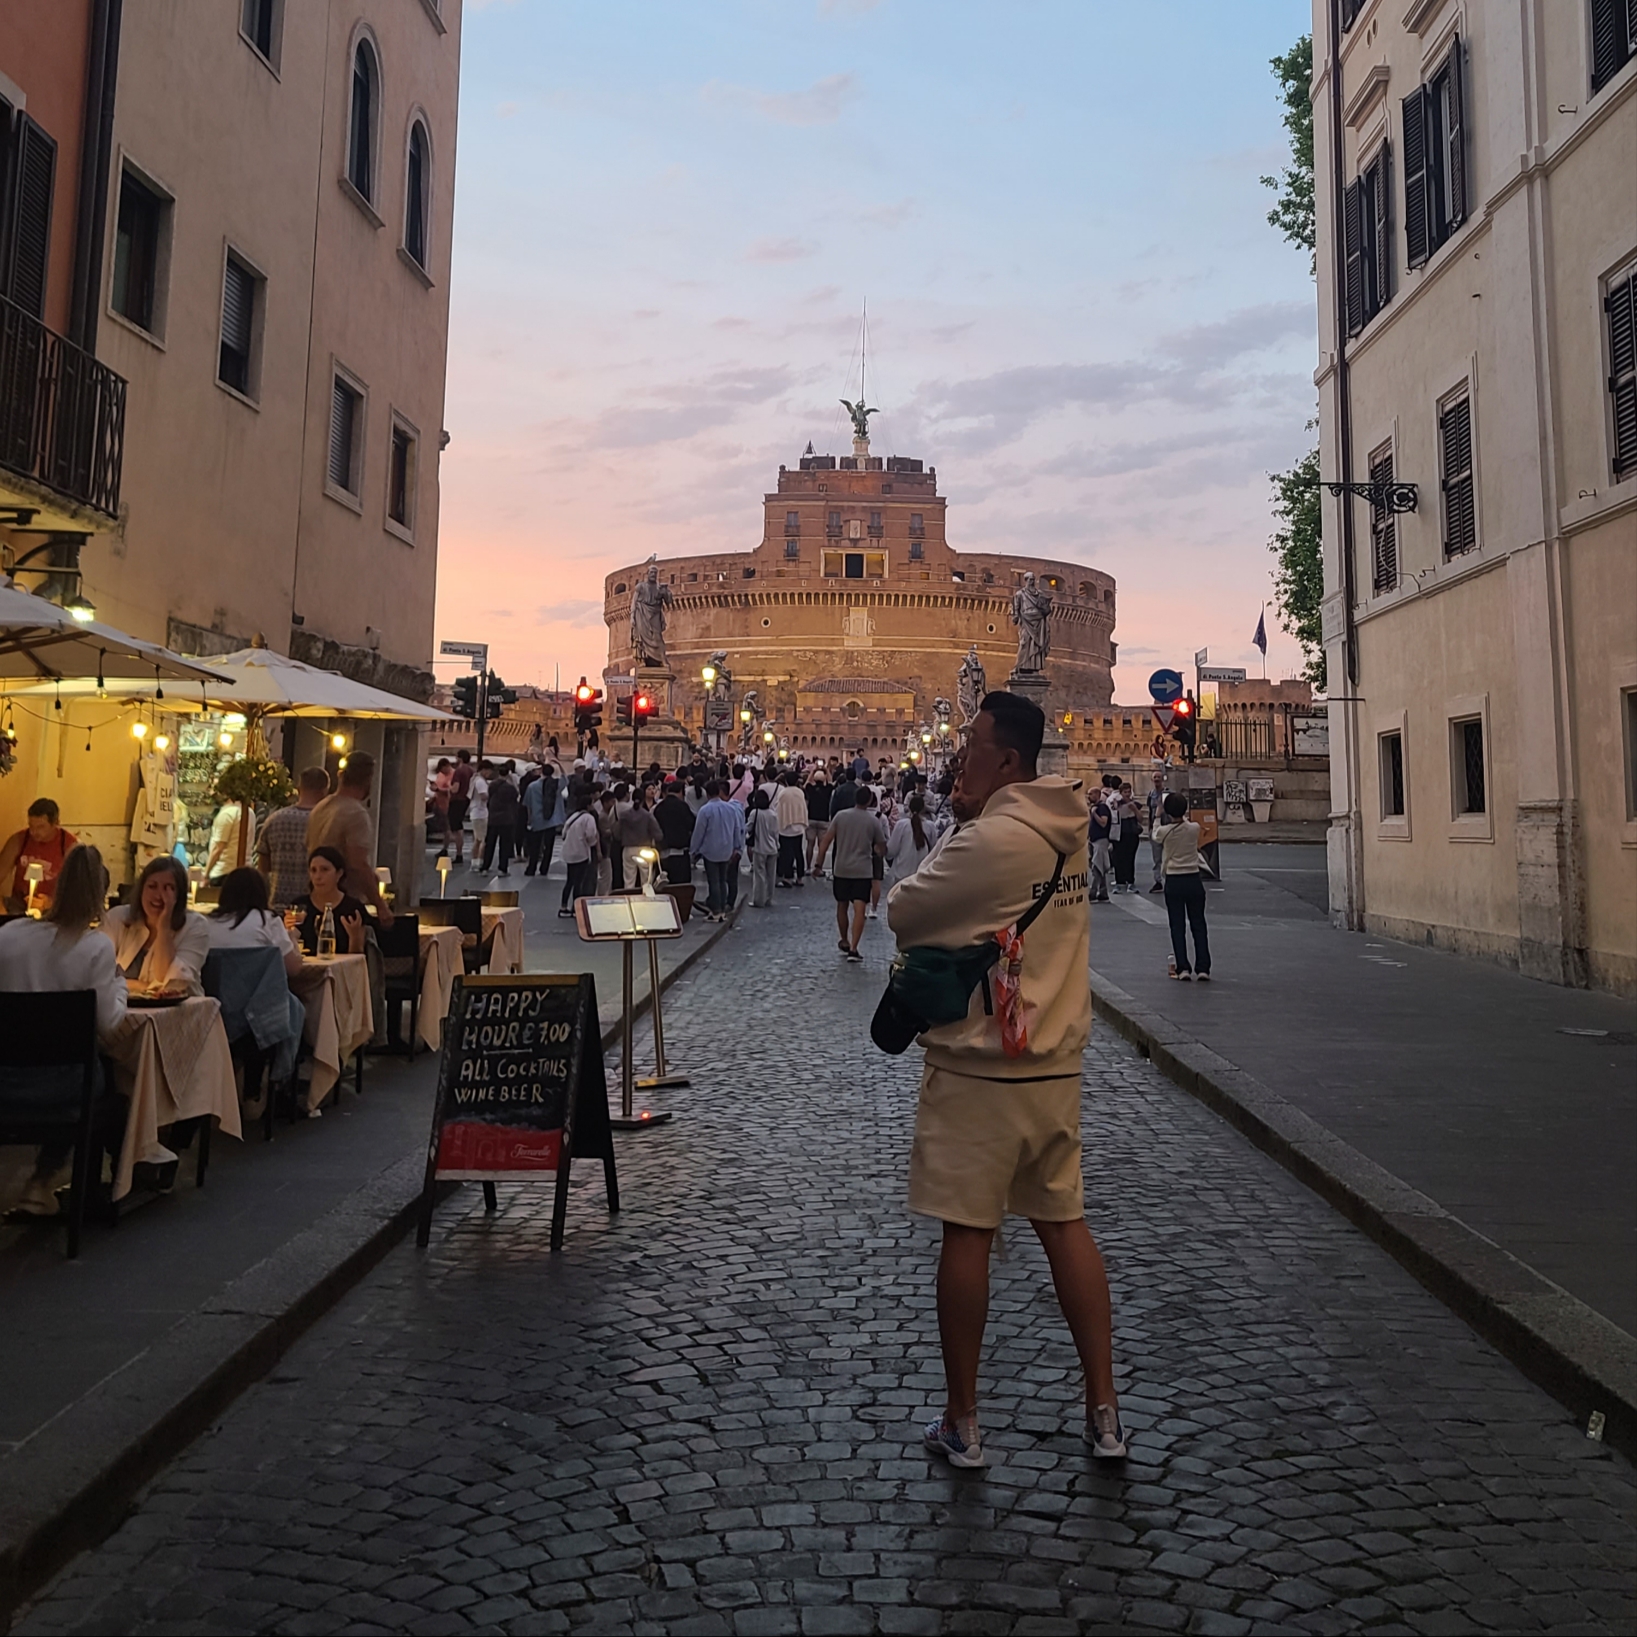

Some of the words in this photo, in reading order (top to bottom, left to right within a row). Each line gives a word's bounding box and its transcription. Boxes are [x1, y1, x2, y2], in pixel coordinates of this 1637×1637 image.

[465, 988, 550, 1019] HAPPY
[461, 1021, 520, 1050] HOUR
[460, 1058, 491, 1081] ALL
[454, 1085, 496, 1105] WINE
[499, 1083, 545, 1103] BEER
